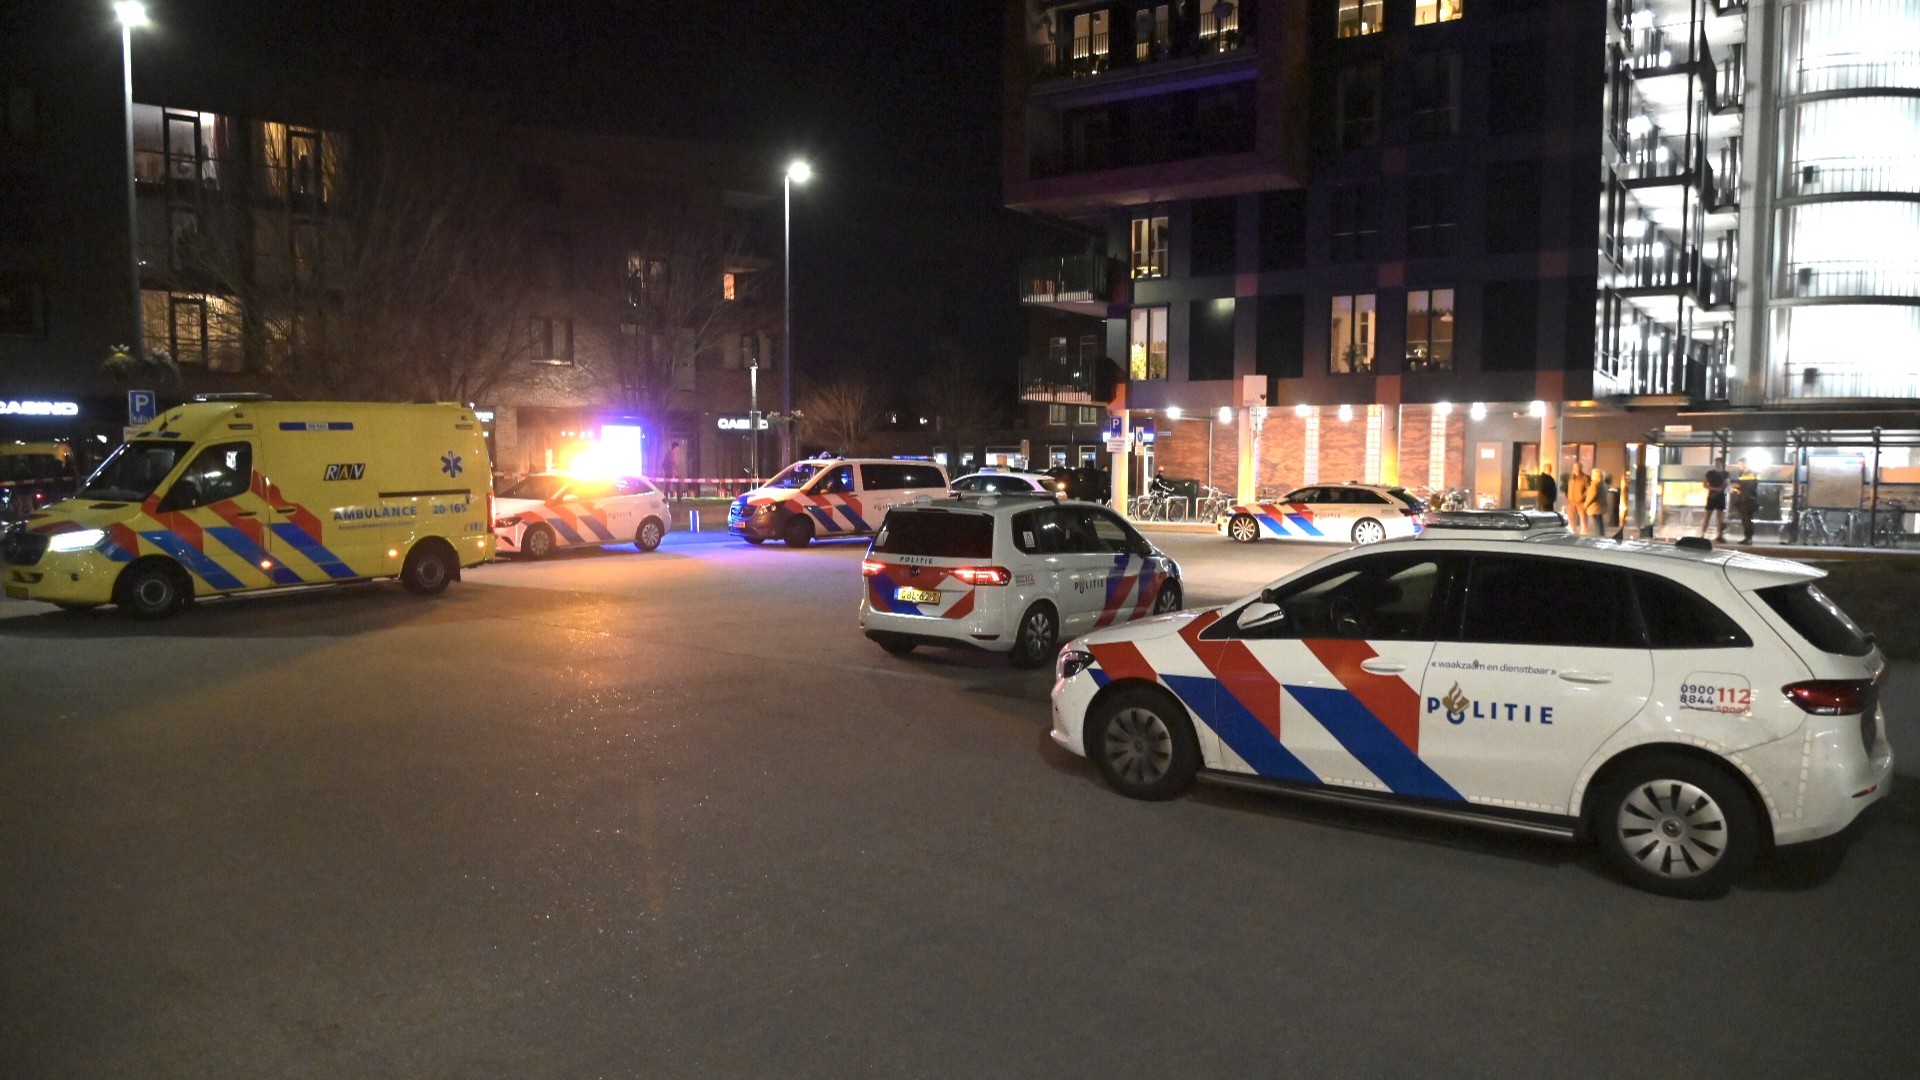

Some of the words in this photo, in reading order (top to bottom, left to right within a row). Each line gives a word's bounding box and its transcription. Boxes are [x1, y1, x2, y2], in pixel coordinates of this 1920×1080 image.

[136, 394, 149, 412] P
[1112, 418, 1120, 429] P
[325, 464, 365, 481] RAV
[333, 506, 417, 520] AMBULANCE
[900, 556, 933, 565] POLITIE
[1074, 579, 1104, 594] POLITIE
[1438, 660, 1485, 670] waakzaam
[1499, 664, 1550, 675] dienstbaar
[1680, 684, 1715, 695] 0900
[1717, 687, 1751, 705] 112
[1680, 694, 1714, 705] 8844
[1427, 696, 1553, 725] POLITIE
